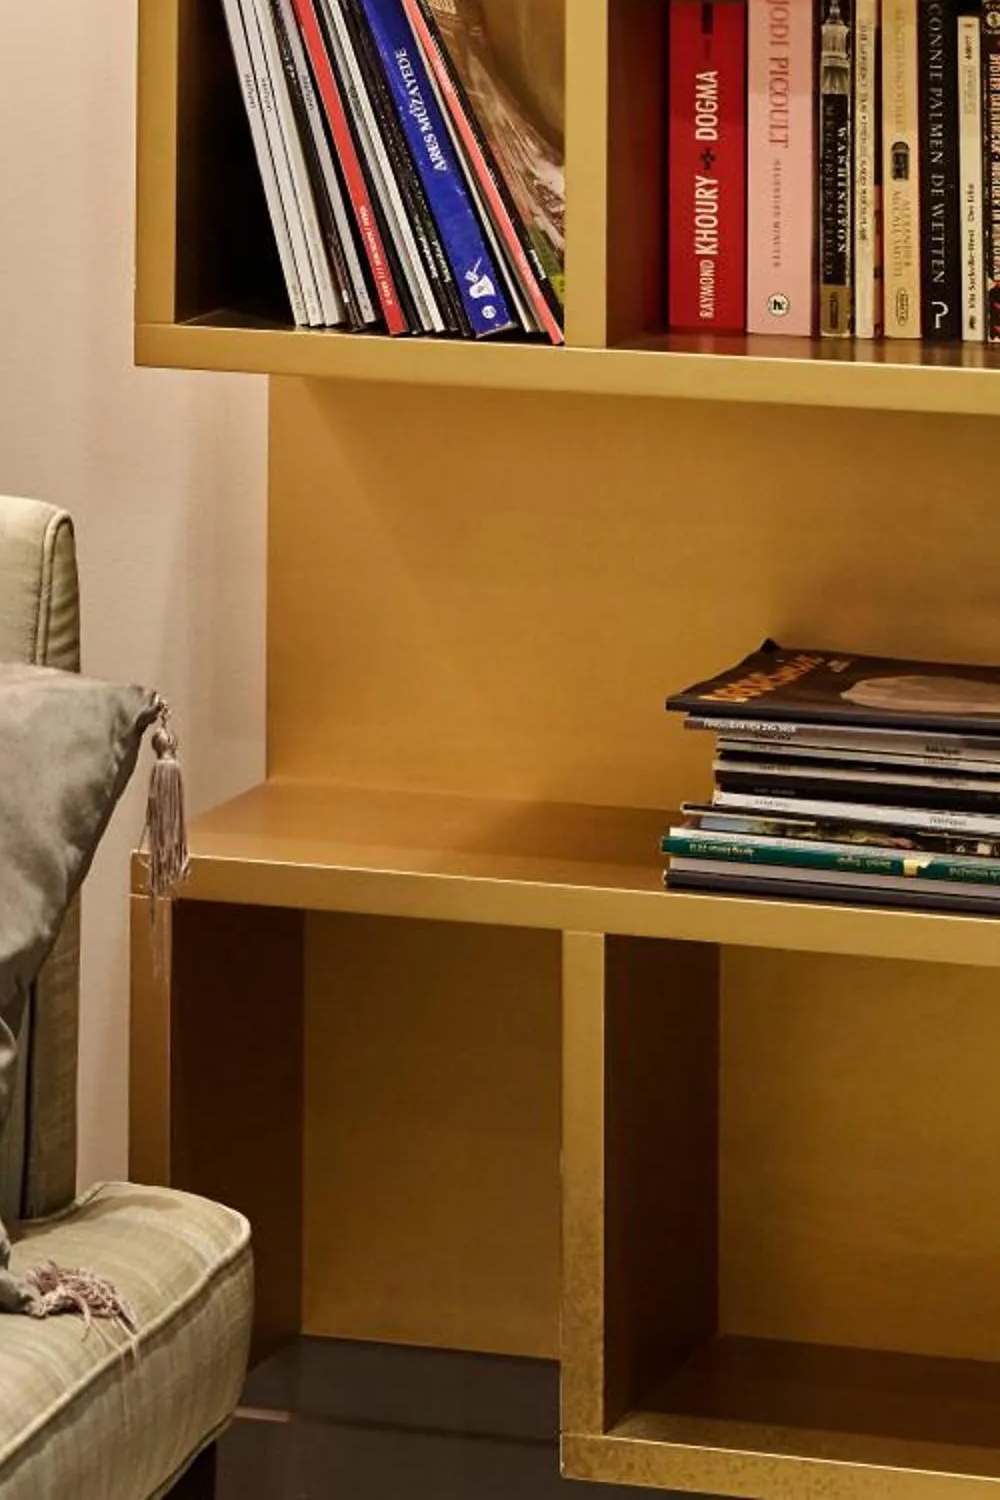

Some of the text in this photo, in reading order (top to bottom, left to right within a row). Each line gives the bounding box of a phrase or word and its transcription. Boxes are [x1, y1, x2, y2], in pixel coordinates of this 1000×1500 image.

[695, 70, 719, 319] RAYMOND KHOURY DOGMA
[768, 56, 790, 149] PICOULT
[837, 127, 848, 255] WASHINGTON
[928, 3, 946, 285] CONNIE PALMEN DE WETTEN
